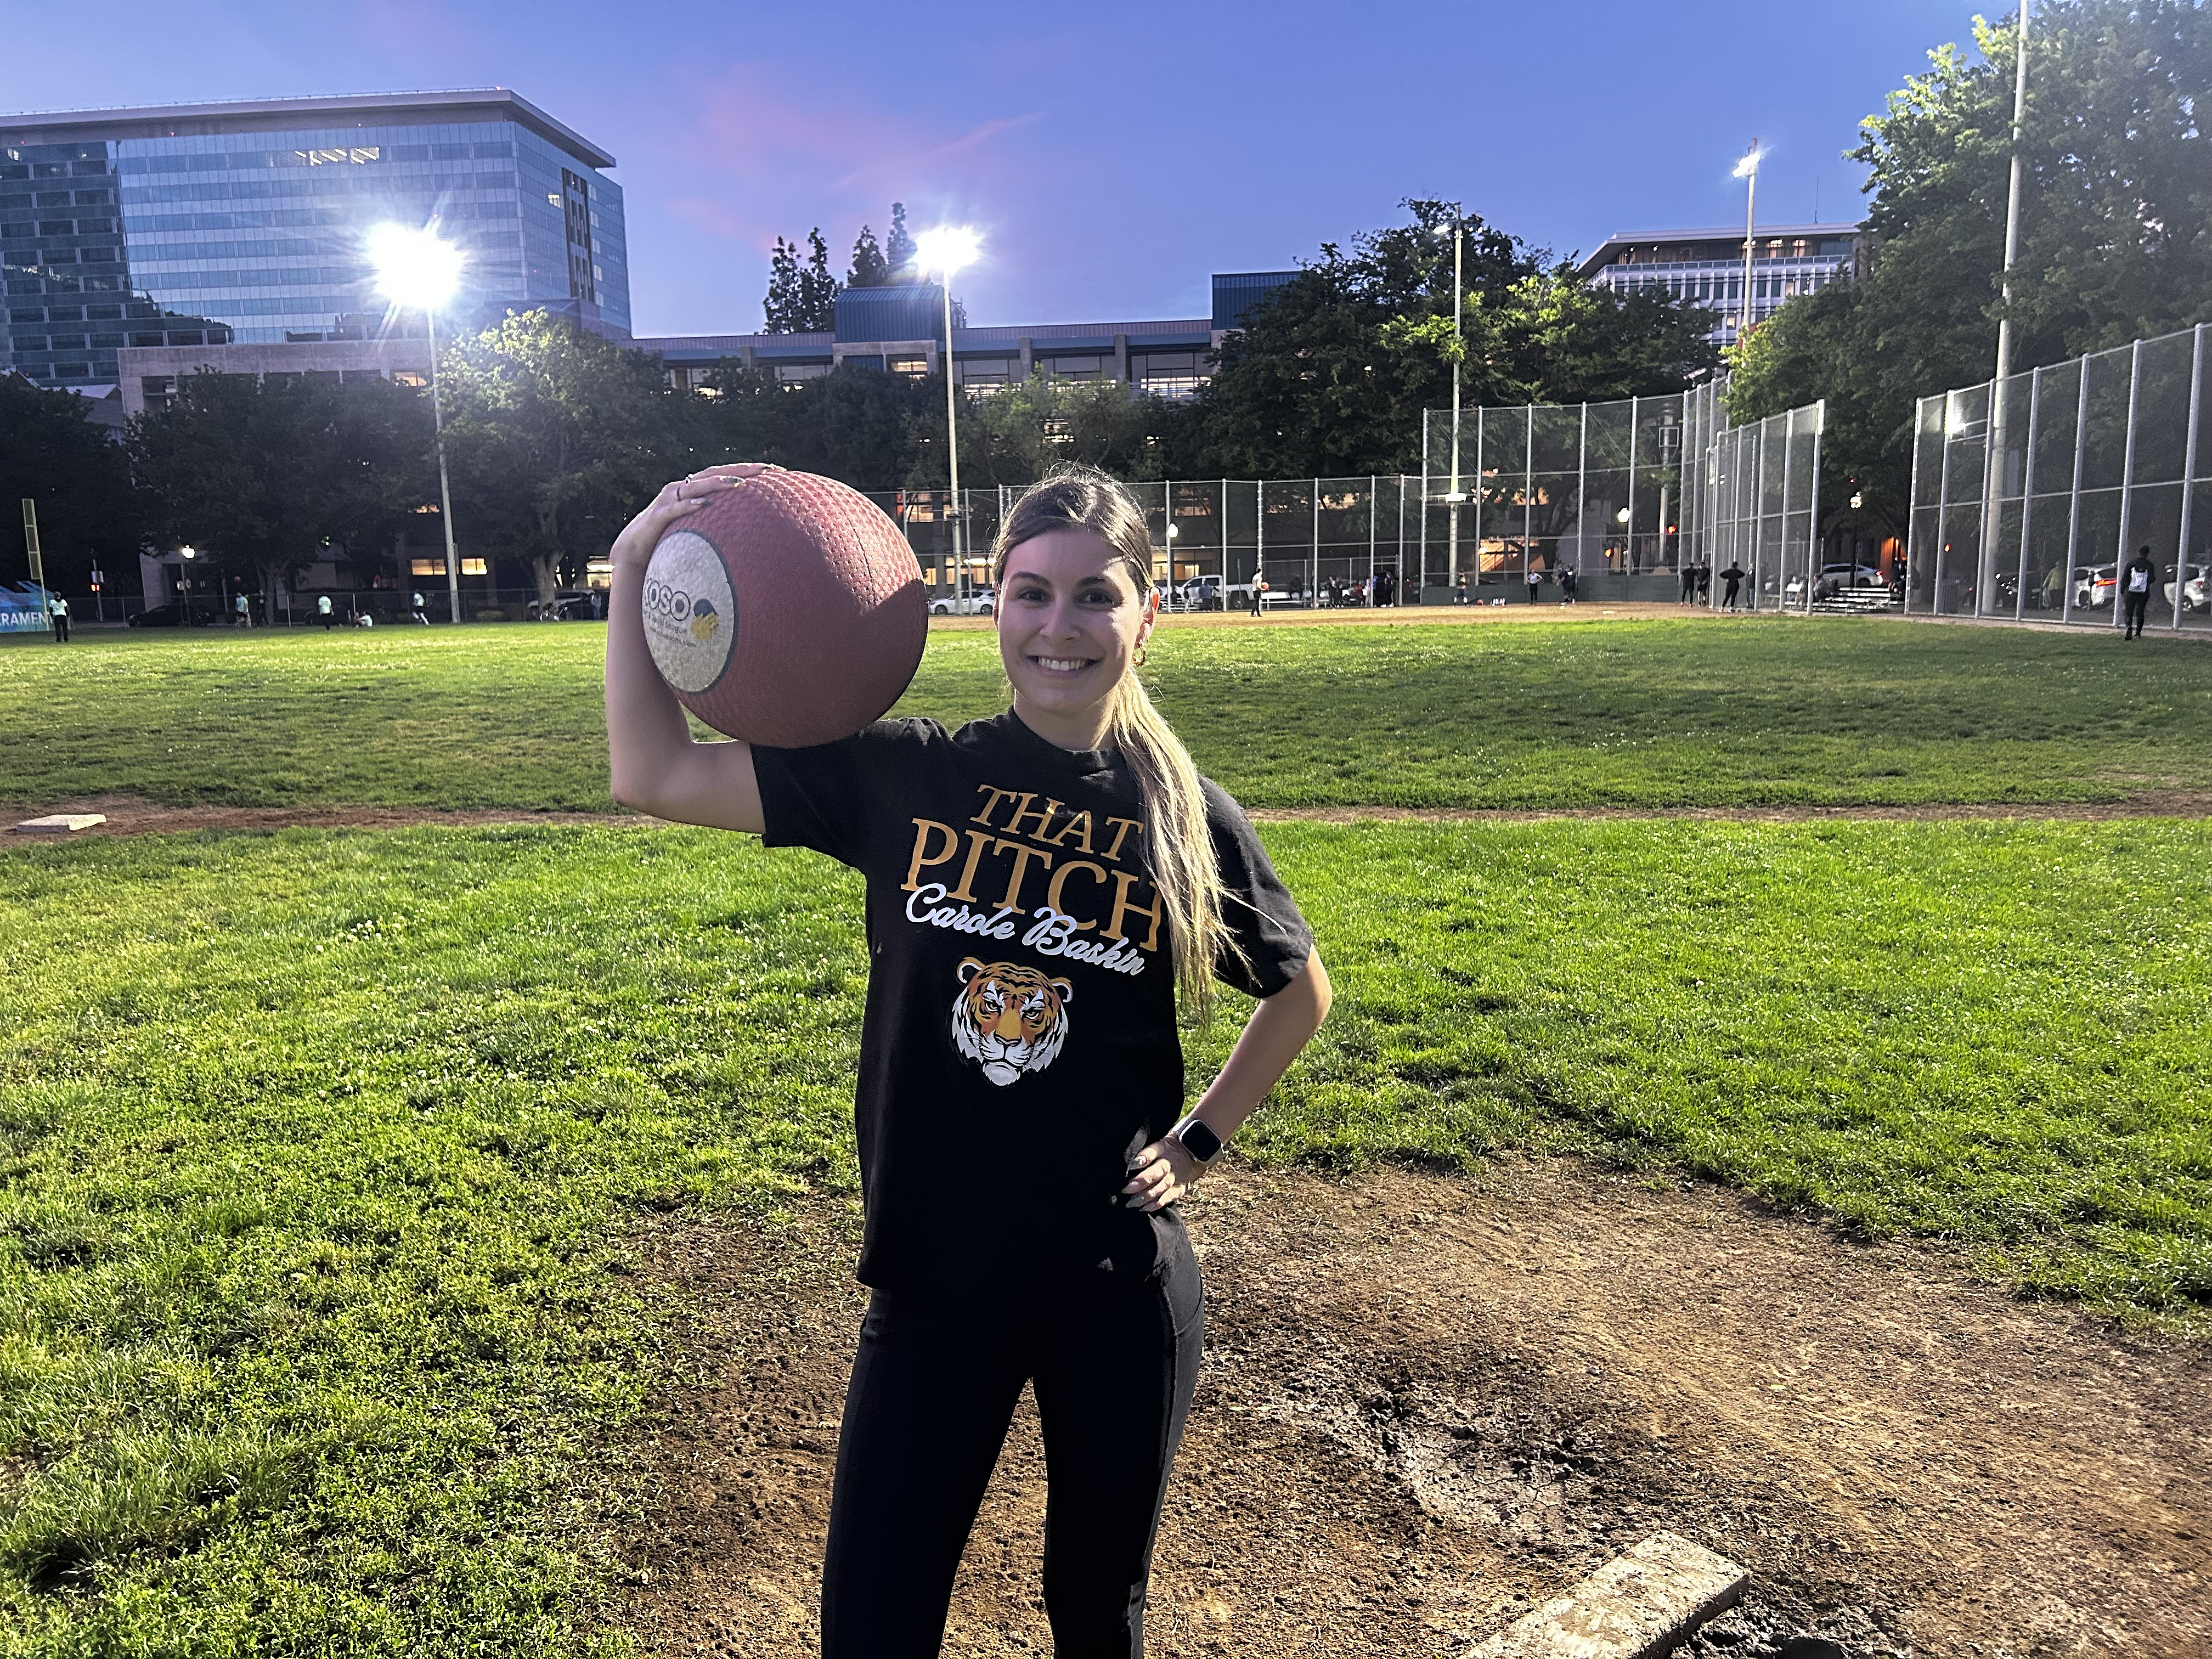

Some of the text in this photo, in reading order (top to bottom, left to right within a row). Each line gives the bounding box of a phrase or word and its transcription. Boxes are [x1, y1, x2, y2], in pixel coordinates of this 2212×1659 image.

[0, 611, 53, 626] RAMENT
[970, 784, 1143, 862] THAT
[900, 818, 1163, 952] PITCH
[906, 883, 1144, 976] Carole Baskin
